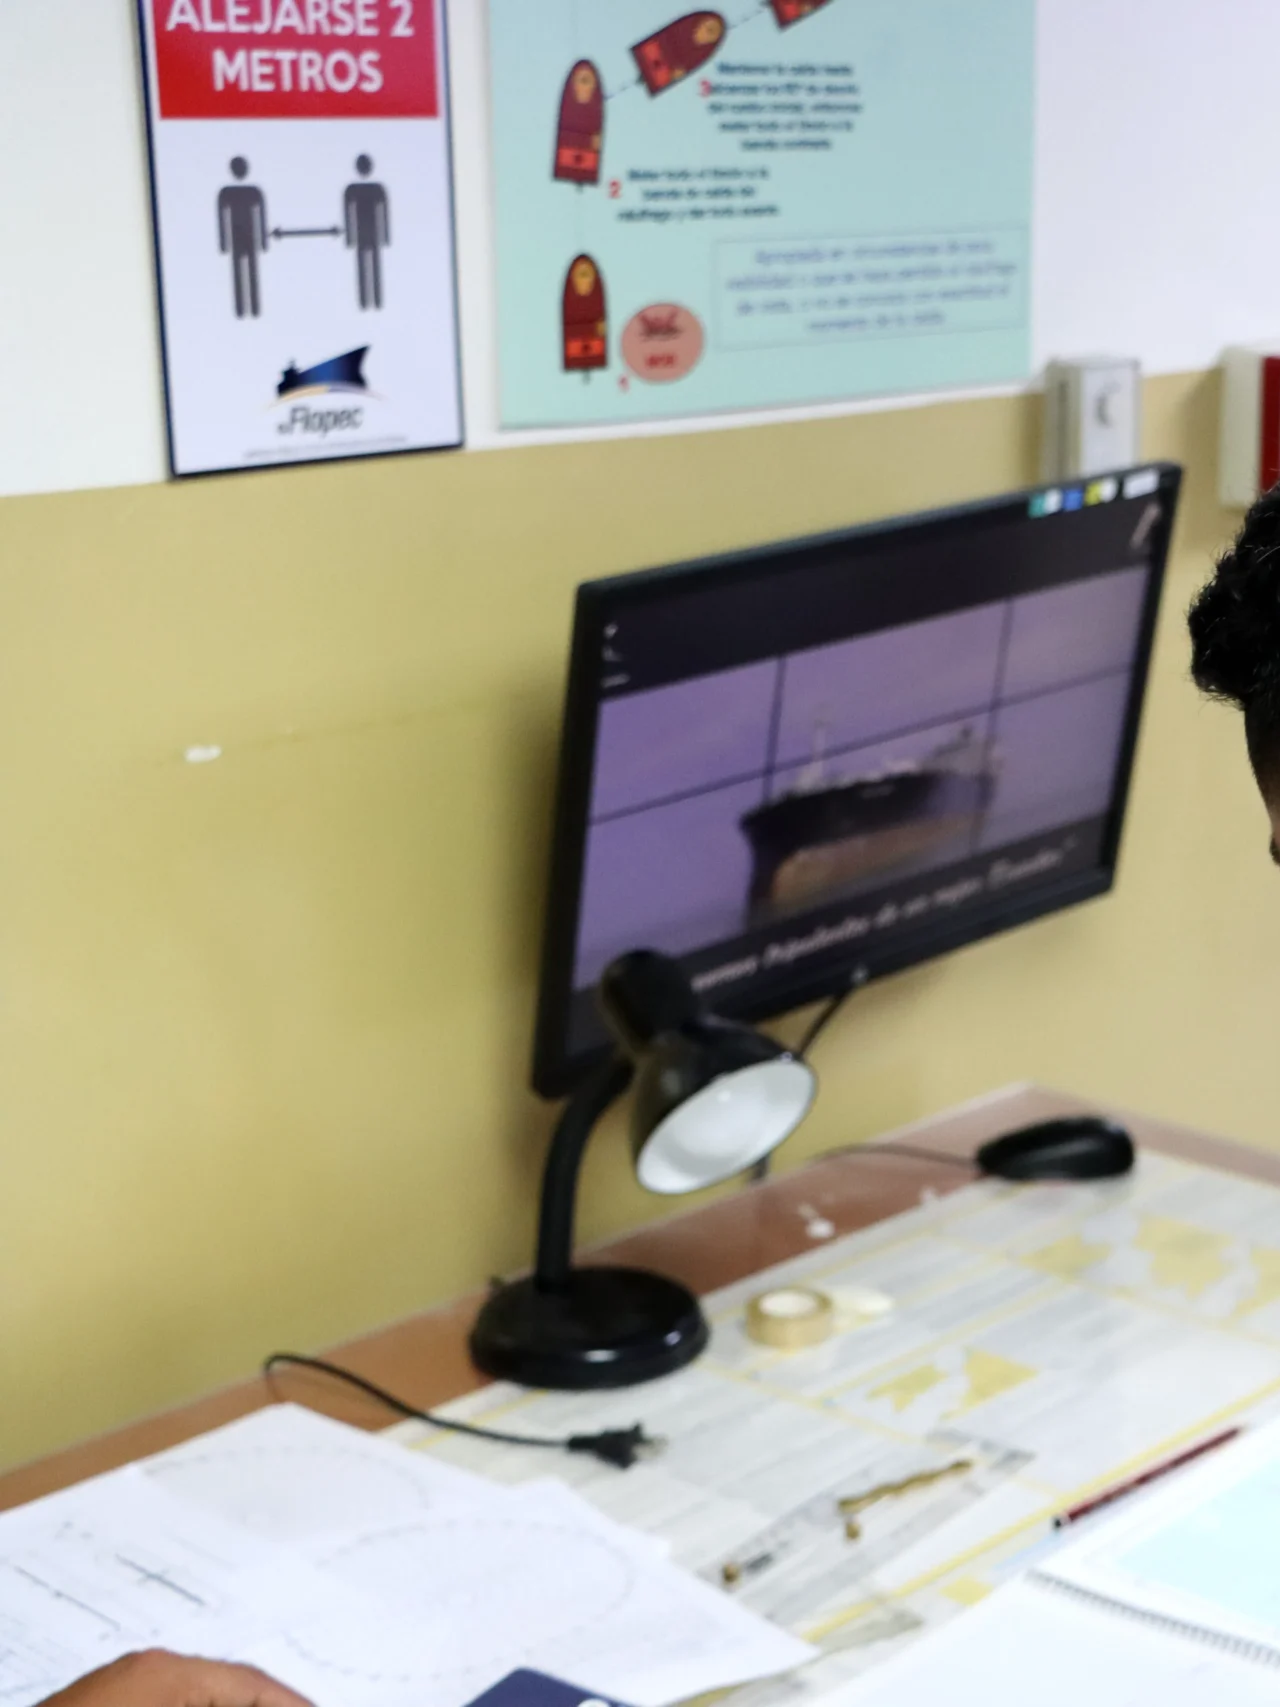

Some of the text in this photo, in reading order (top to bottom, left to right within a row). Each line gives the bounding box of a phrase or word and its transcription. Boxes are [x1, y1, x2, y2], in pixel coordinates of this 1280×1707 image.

[166, 0, 415, 37] ALEJARSE 2
[212, 48, 384, 93] METROS
[608, 179, 622, 199] 2
